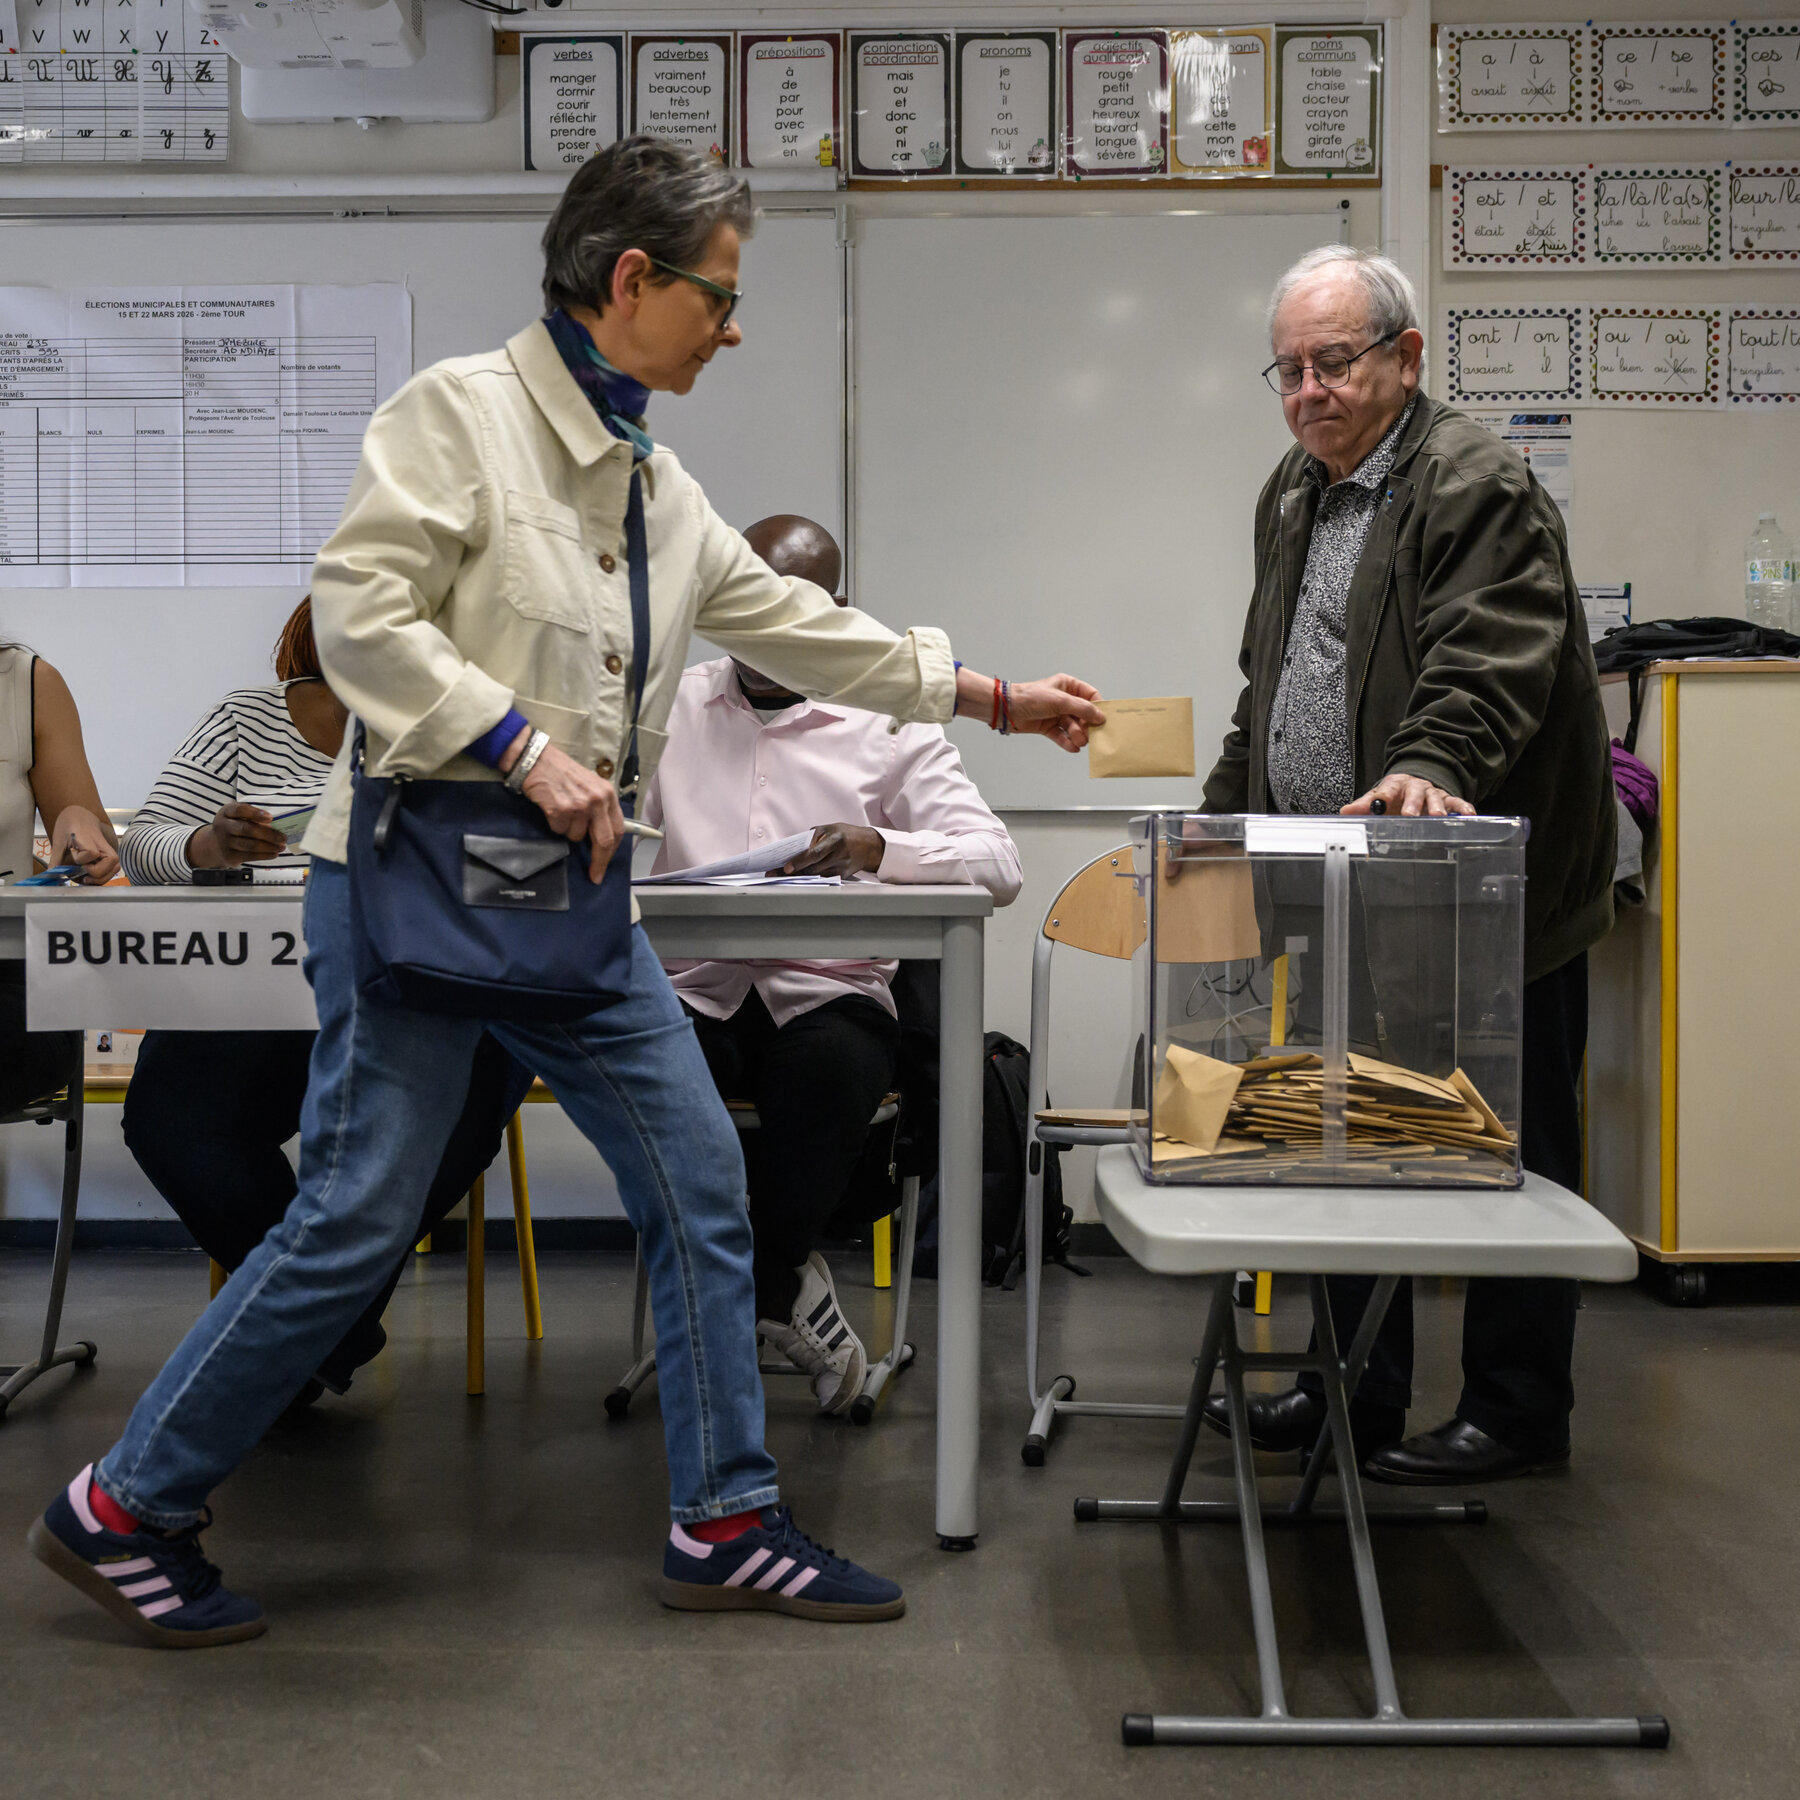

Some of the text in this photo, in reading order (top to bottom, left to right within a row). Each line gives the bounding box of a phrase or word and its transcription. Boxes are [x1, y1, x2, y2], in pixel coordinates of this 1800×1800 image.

[156, 30, 168, 52] y
[1311, 41, 1343, 49] noms
[756, 47, 825, 58] prépositions
[864, 43, 938, 54] conjonctions
[981, 47, 1031, 57] pronoms
[554, 50, 592, 59] verbes
[654, 50, 708, 59] adverbes
[864, 54, 939, 64] coordination
[1083, 52, 1150, 63] qualificat
[1298, 51, 1356, 60] communs
[1482, 49, 1544, 65] a à
[1617, 51, 1693, 63] ce se
[1751, 50, 1782, 62] ces
[655, 71, 706, 80] vraiment
[786, 67, 794, 77] à
[888, 71, 913, 80] mais
[999, 66, 1010, 78] je
[1098, 70, 1133, 81] rouge
[1311, 67, 1341, 77] table
[551, 74, 596, 85] manger
[649, 84, 711, 95] beaucoup
[782, 81, 797, 90] de
[893, 86, 908, 94] ou
[1000, 81, 1010, 90] tu
[1103, 83, 1129, 94] petit
[1307, 81, 1345, 90] chaise
[1471, 84, 1506, 95] avait
[557, 87, 595, 96] dormir
[670, 97, 689, 106] très
[780, 94, 800, 104] par
[895, 98, 907, 107] et
[1002, 96, 1007, 105] il
[1099, 96, 1134, 108] grand
[1302, 95, 1350, 104] docteur
[557, 100, 590, 109] courir
[650, 110, 709, 120] lentement
[777, 108, 803, 117] pour
[886, 111, 916, 121] donc
[997, 112, 1012, 120] on
[1093, 109, 1140, 119] heureux
[1307, 109, 1348, 118] crayon
[551, 113, 596, 123] réfléchir
[775, 121, 804, 130] avec
[896, 125, 908, 134] or
[1095, 123, 1138, 133] bavard
[1205, 122, 1236, 131] cette
[1306, 122, 1345, 131] voiture
[551, 127, 596, 138] prendre
[991, 127, 1018, 135] nous
[782, 134, 798, 143] sur
[897, 139, 906, 147] ni
[1096, 136, 1136, 147] longue
[1207, 136, 1234, 144] mon
[1308, 135, 1342, 147] girafe
[558, 141, 590, 151] poser
[999, 140, 1011, 150] lui
[783, 149, 797, 157] en
[892, 152, 912, 161] car
[1097, 150, 1135, 159] sévère
[1205, 148, 1235, 158] votre
[1306, 149, 1344, 158] enfant
[563, 154, 584, 163] dire
[1477, 188, 1556, 205] est et
[1475, 225, 1504, 236] était
[1516, 239, 1567, 256] et puis
[1468, 326, 1560, 344] ont on
[1605, 329, 1690, 344] ou où
[27, 339, 48, 348] 235
[1463, 357, 1552, 374] avaient il
[1620, 357, 1643, 372] bien
[48, 931, 306, 965] BUREAU 2
